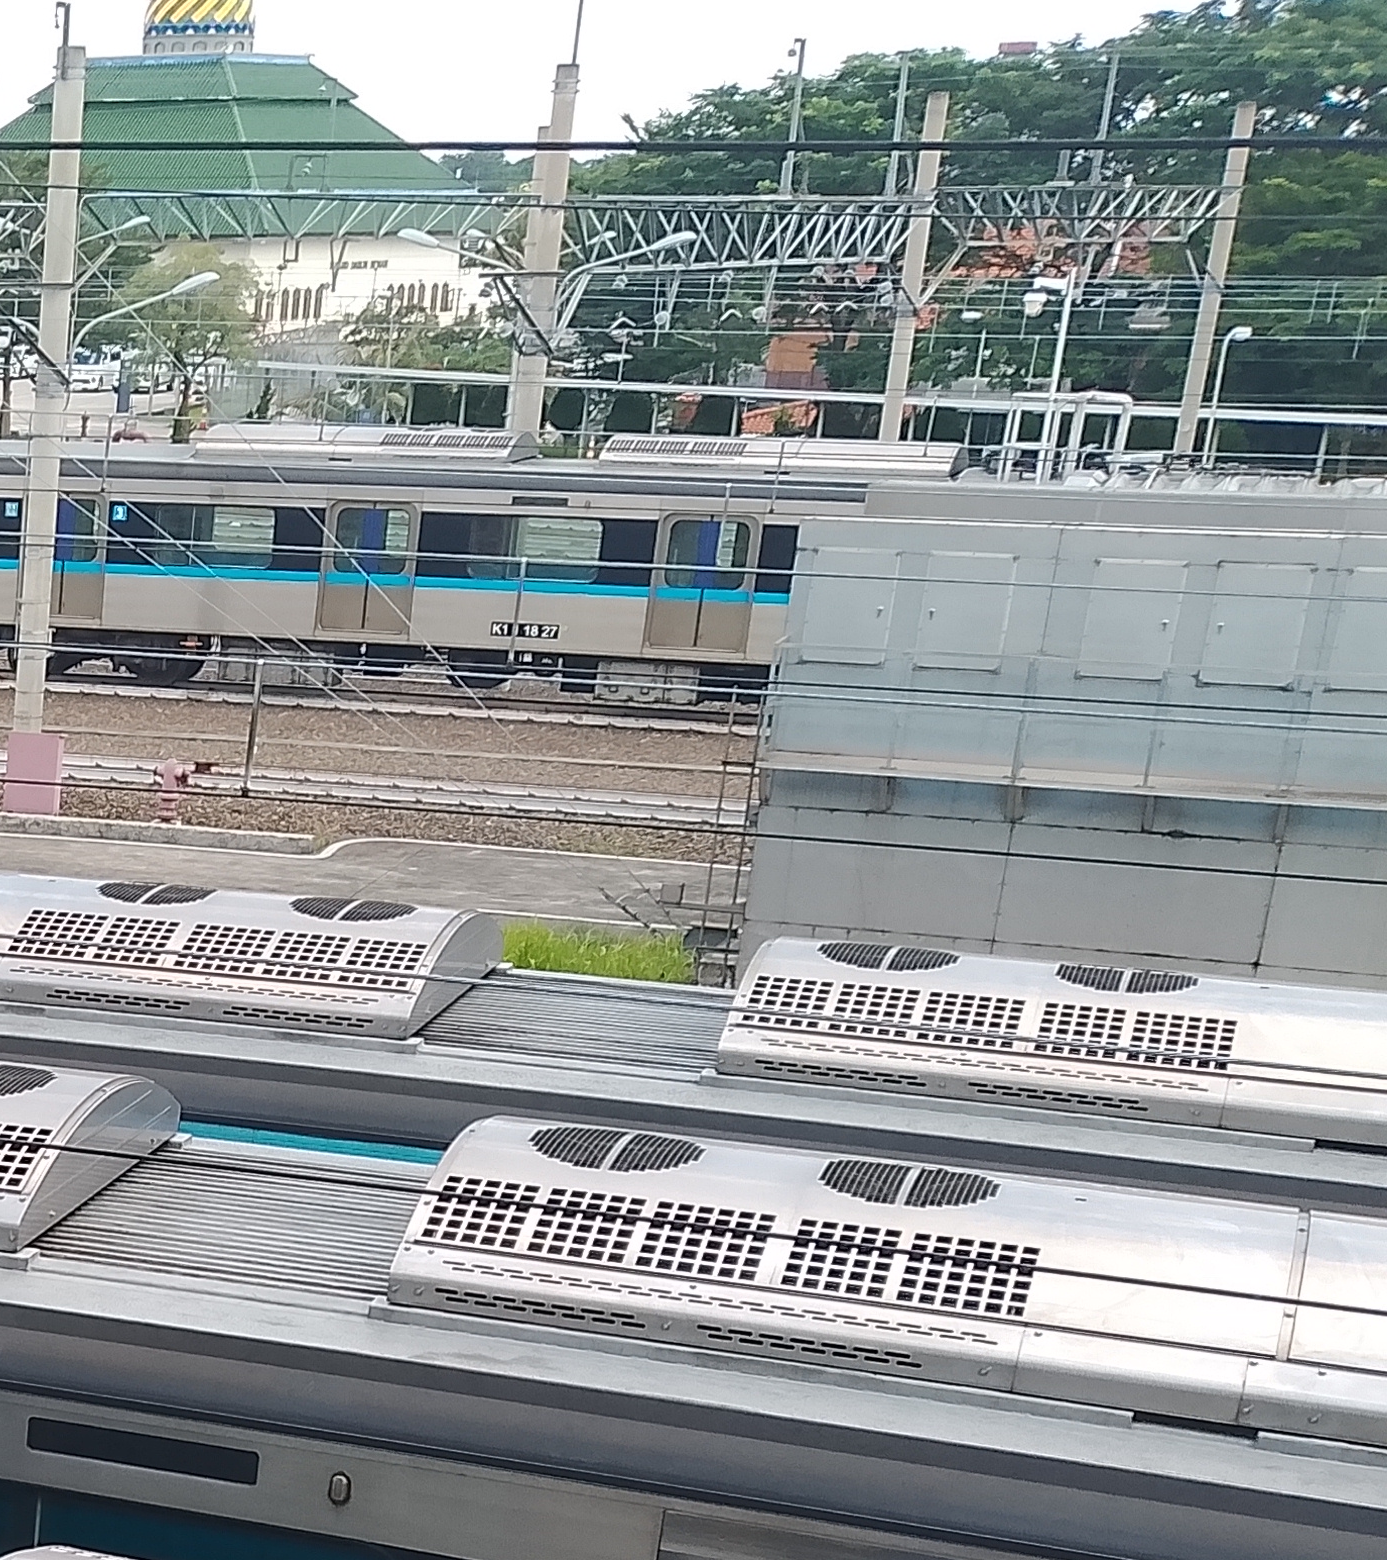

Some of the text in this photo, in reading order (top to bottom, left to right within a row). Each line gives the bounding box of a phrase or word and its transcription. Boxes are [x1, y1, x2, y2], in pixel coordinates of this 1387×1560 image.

[492, 623, 508, 636] K1
[523, 624, 539, 637] 18
[541, 625, 558, 638] 27
